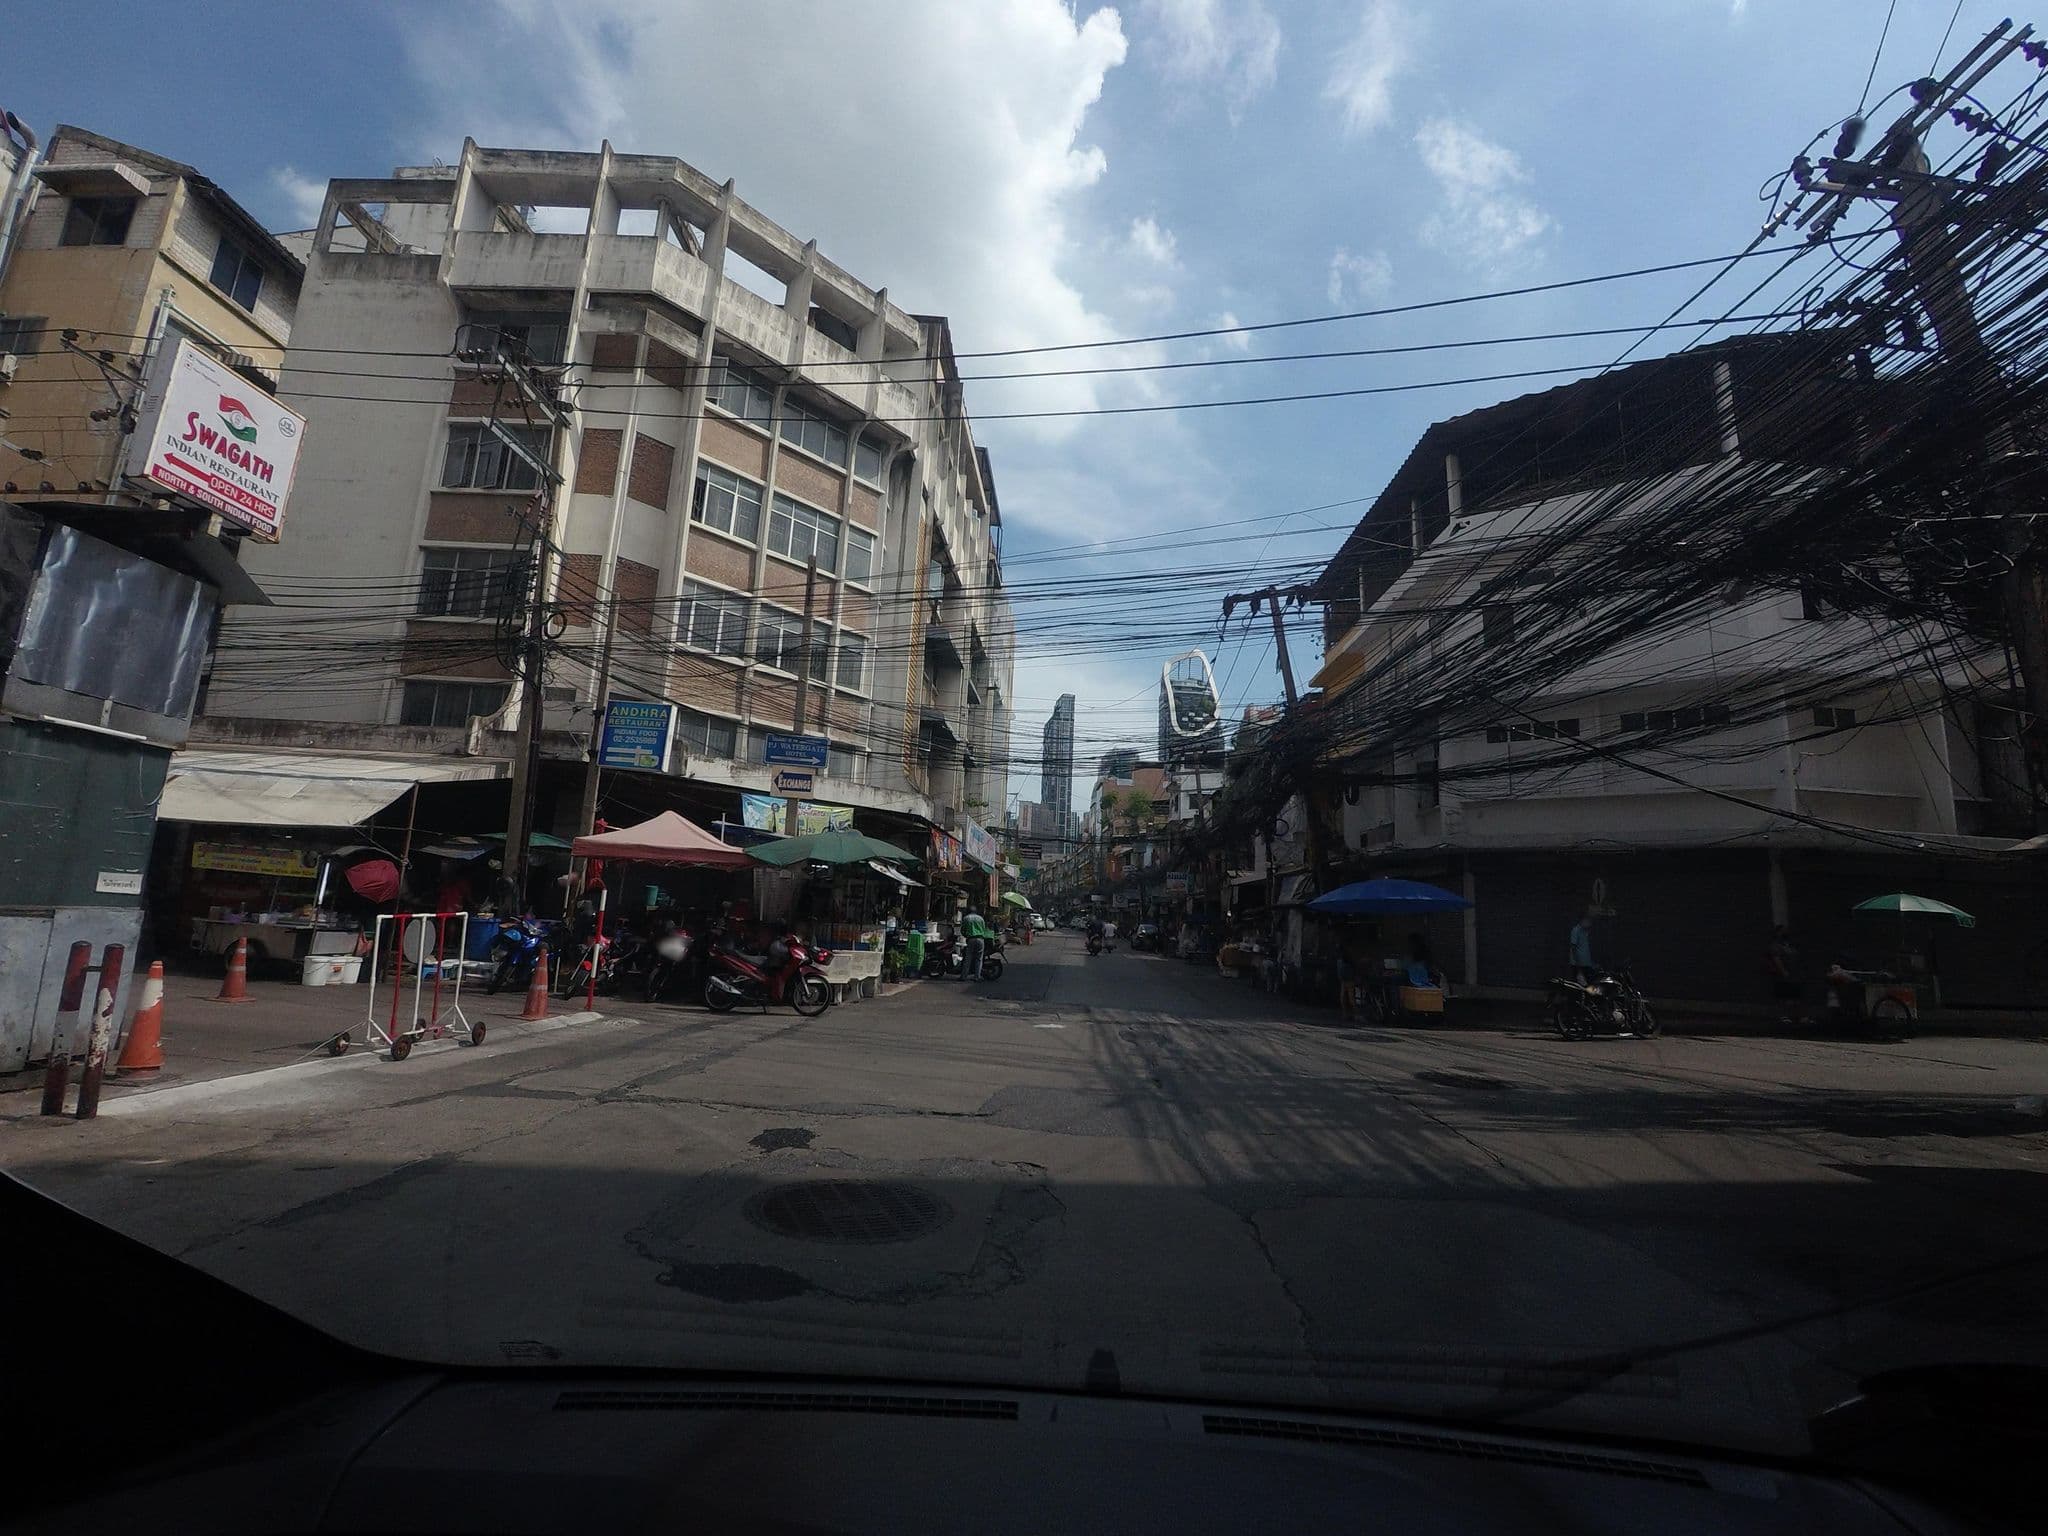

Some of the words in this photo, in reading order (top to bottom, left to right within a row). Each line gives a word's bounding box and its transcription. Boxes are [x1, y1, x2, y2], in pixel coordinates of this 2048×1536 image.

[182, 411, 275, 484] SWAGATH
[166, 434, 209, 465] INDIAN
[208, 459, 281, 504] RESTAURANT
[157, 468, 188, 490] NORTH
[188, 484, 196, 495] &
[196, 488, 224, 510] SOUTH
[224, 502, 252, 524] INDIAN
[251, 516, 273, 534] FOOD
[210, 476, 238, 500] OPEN
[239, 490, 253, 508] 24
[254, 500, 275, 518] HRS
[610, 706, 668, 718] ANDHRA
[608, 718, 668, 728] RESTAURANT
[614, 728, 637, 736] INDIAN
[780, 742, 826, 753] WATERGATE
[777, 774, 811, 790] EXCHANGE
